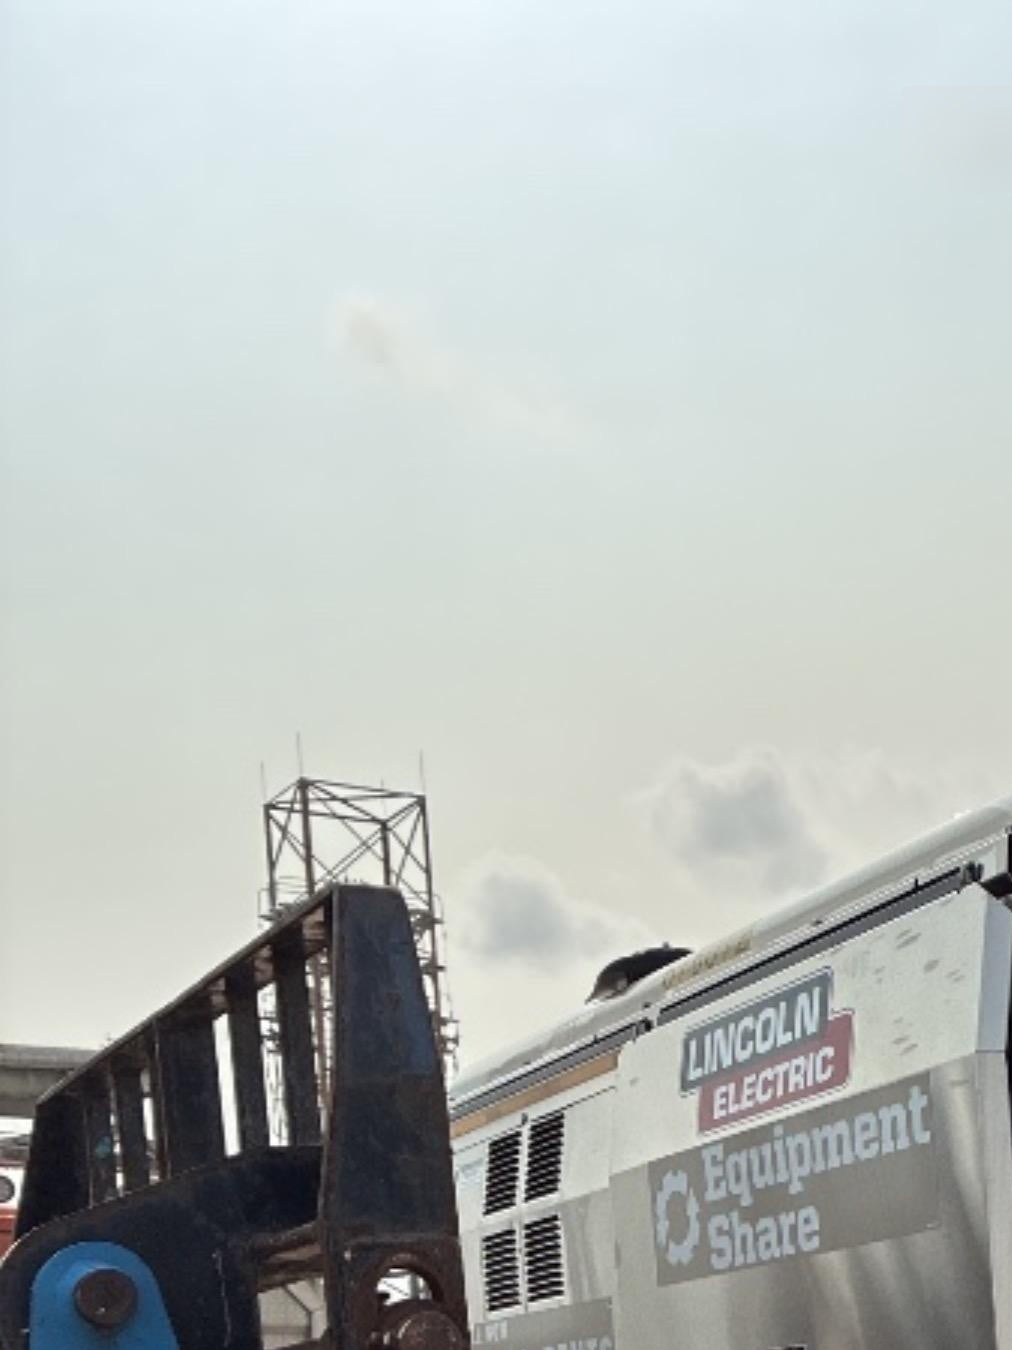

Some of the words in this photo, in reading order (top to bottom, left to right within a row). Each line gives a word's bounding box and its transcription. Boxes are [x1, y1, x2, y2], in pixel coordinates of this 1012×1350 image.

[686, 986, 821, 1081] LINCOLN
[713, 1046, 835, 1120] ELECTRIC
[702, 1085, 931, 1206] Equipment
[707, 1205, 820, 1270] Share
